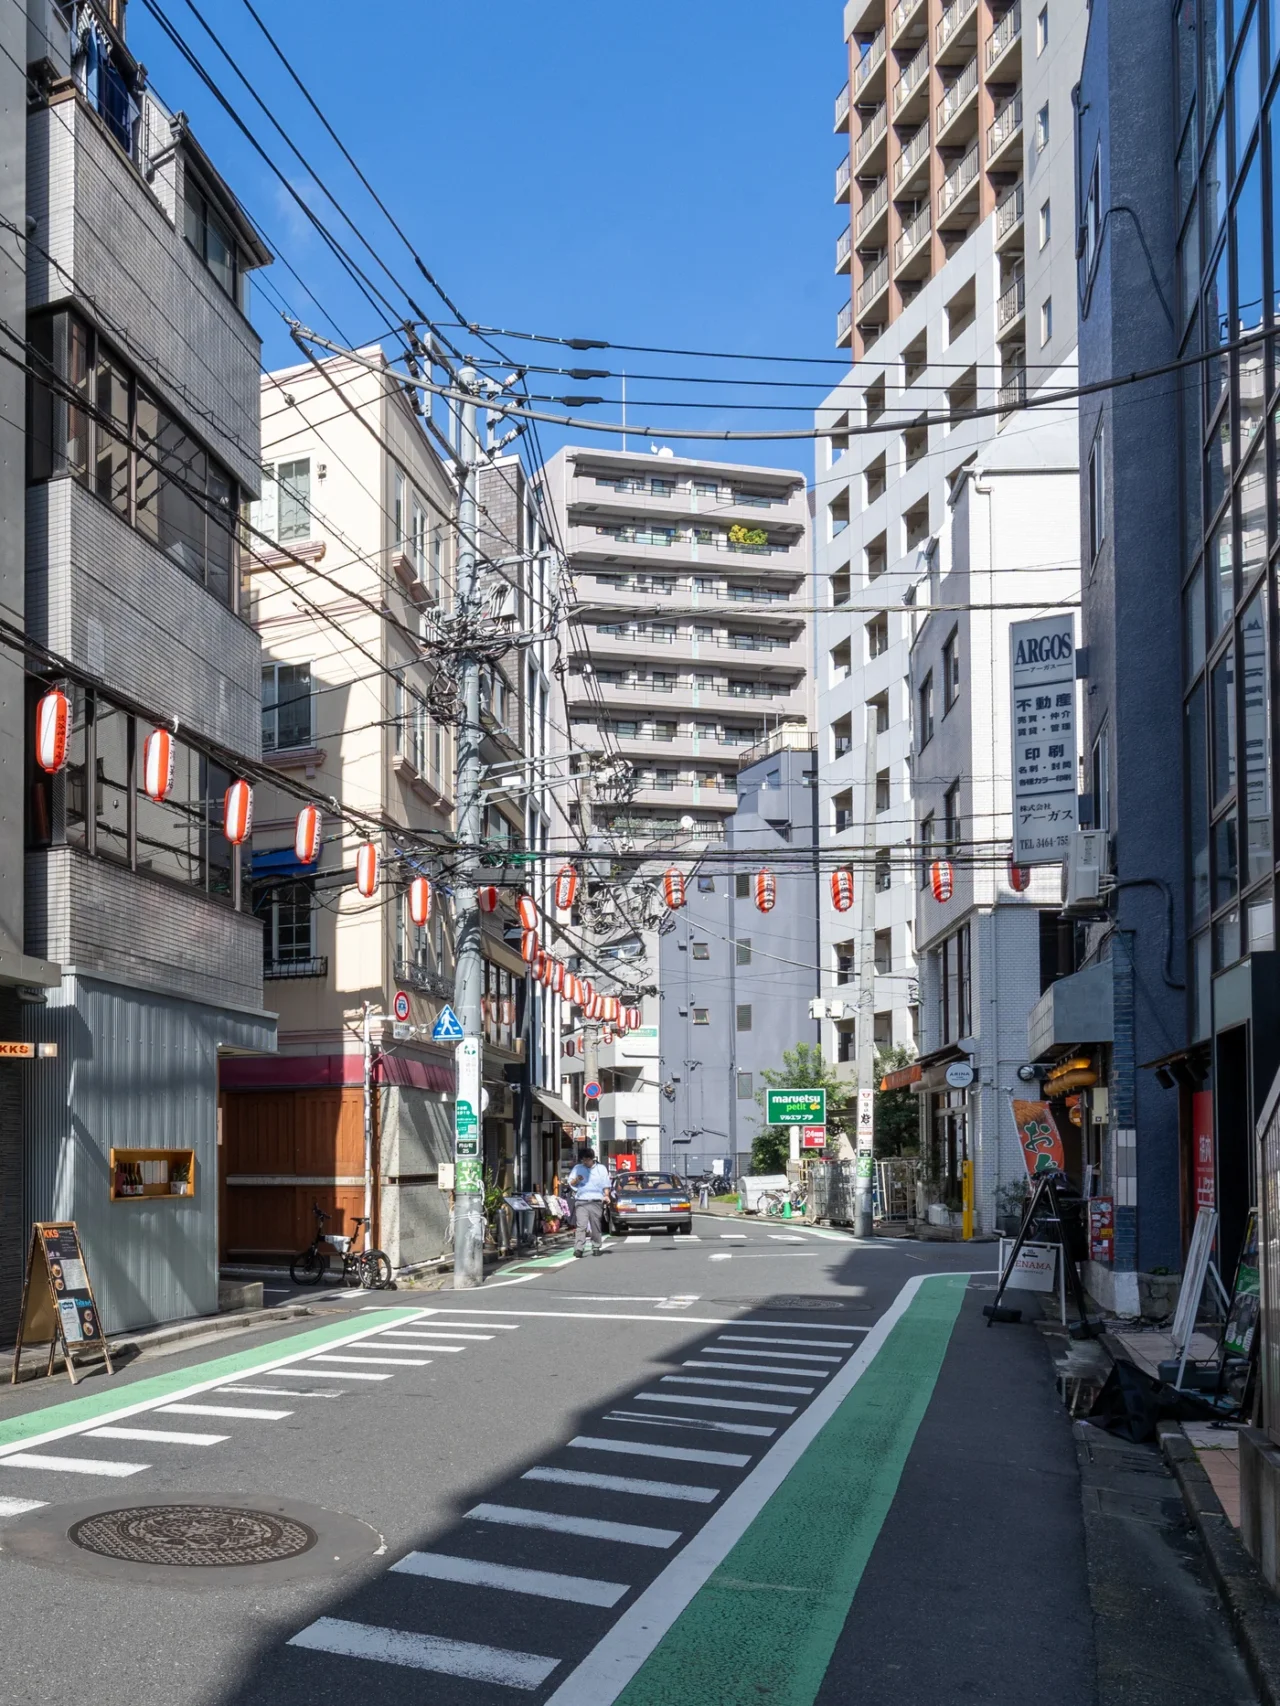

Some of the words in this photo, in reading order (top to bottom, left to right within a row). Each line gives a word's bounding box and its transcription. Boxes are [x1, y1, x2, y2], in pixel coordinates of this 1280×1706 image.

[1014, 632, 1072, 665] ARGOS
[1030, 664, 1056, 673] アーガス
[1016, 693, 1072, 712] 不動産
[1017, 710, 1071, 724] 売買・仲介
[1017, 722, 1071, 736] 賃貸・管理
[1025, 744, 1065, 761] 印刷
[1020, 803, 1051, 812] 株式会社
[1020, 810, 1073, 825] アーガス
[1020, 839, 1034, 850] TEL
[1036, 835, 1069, 848] 3464-755
[0, 1045, 28, 1054] KKS
[772, 1095, 821, 1103] maruetsu
[786, 1103, 807, 1112] petit
[43, 1229, 59, 1238] KKS
[1014, 1260, 1053, 1271] ENAMA
